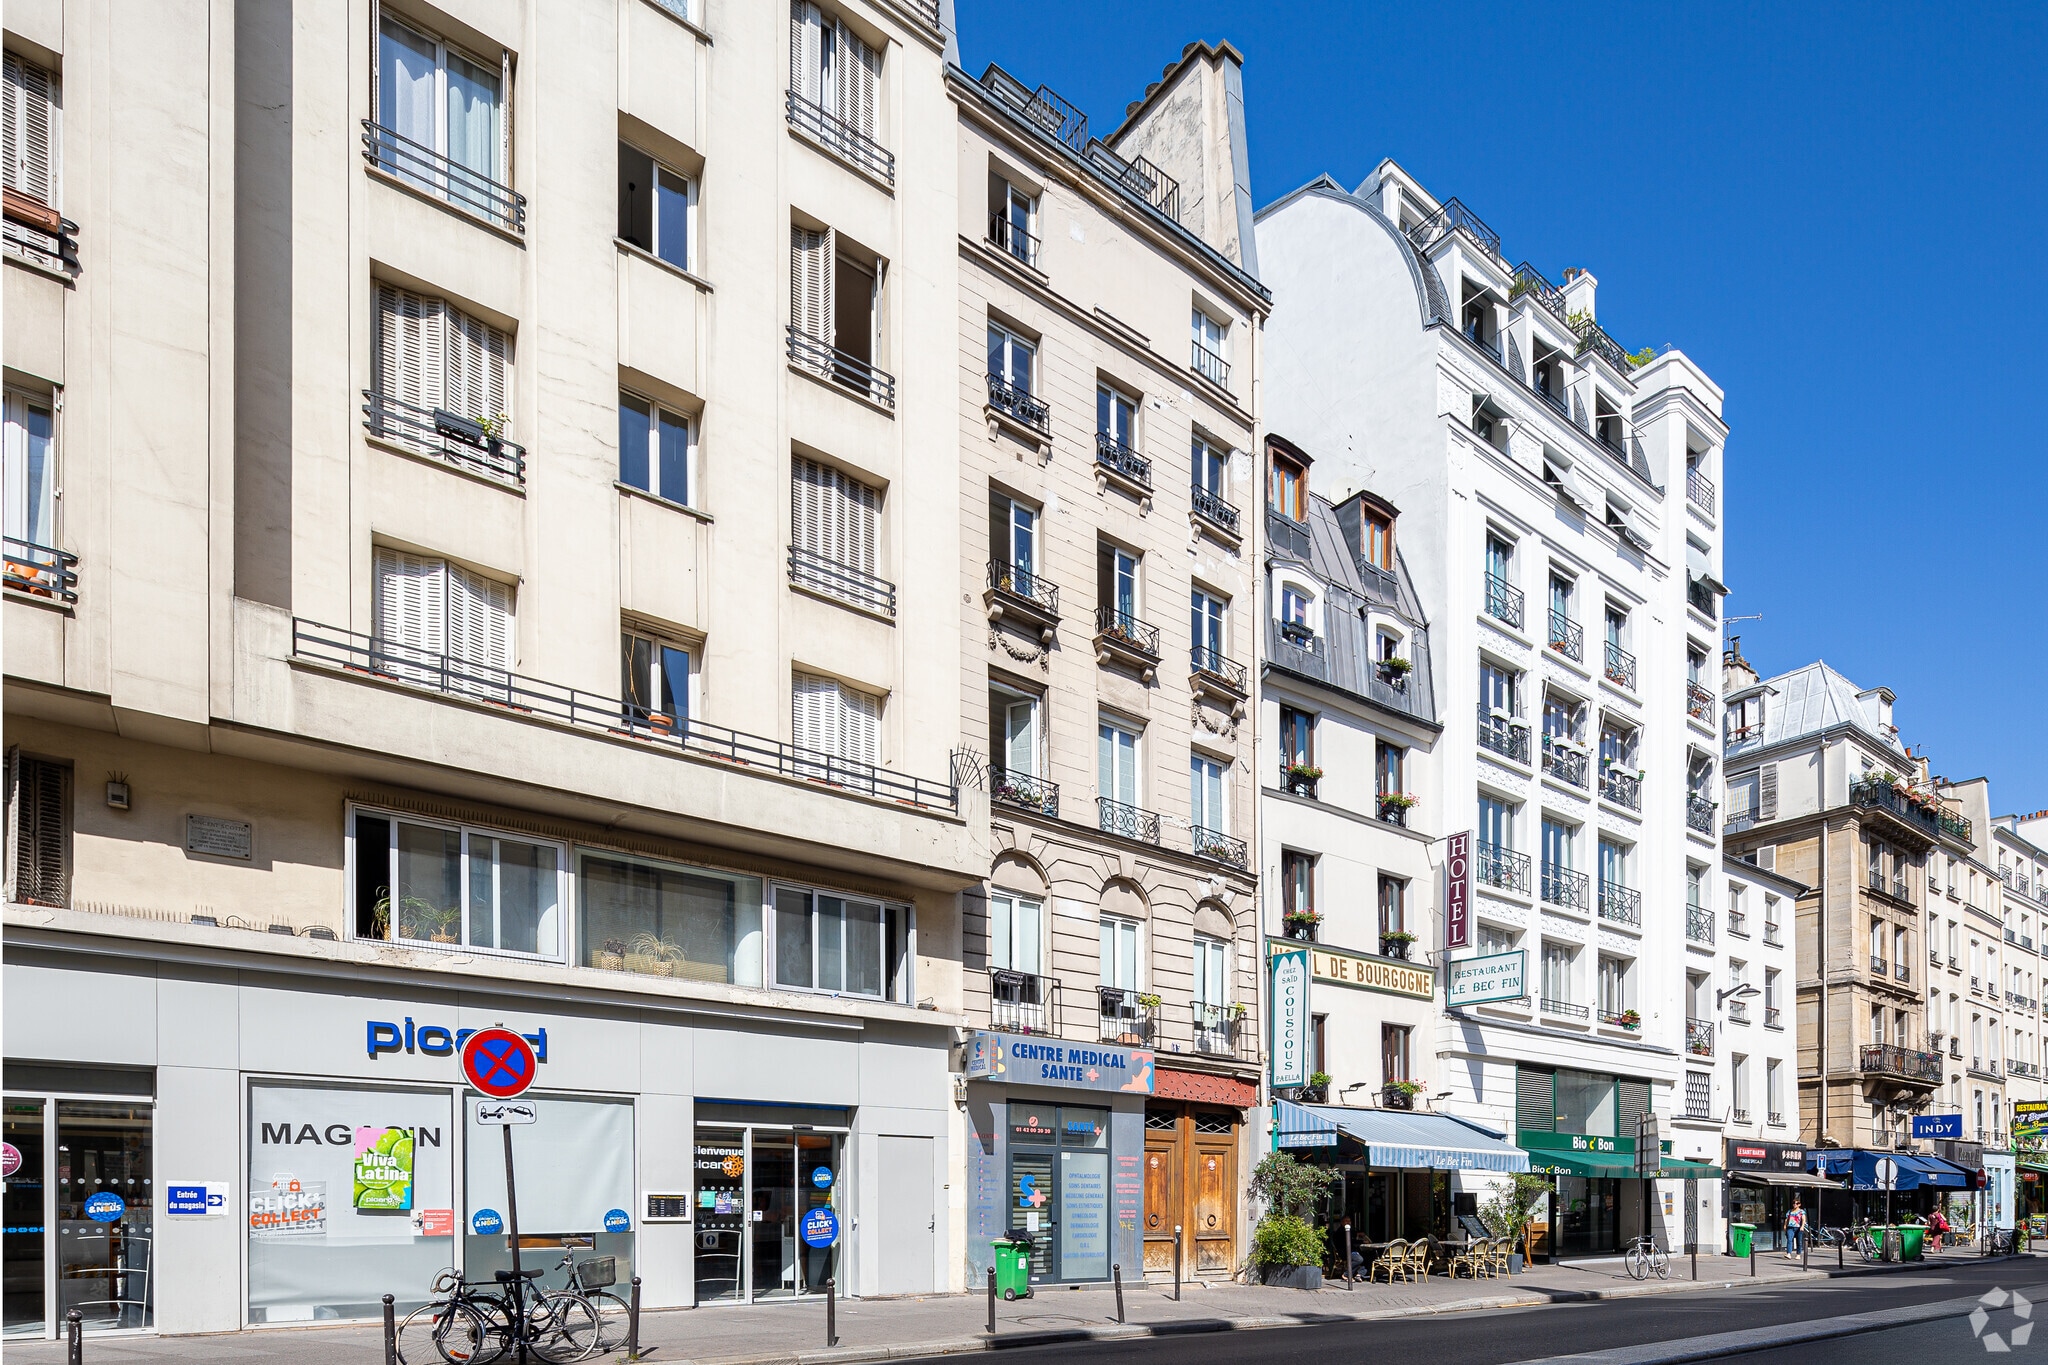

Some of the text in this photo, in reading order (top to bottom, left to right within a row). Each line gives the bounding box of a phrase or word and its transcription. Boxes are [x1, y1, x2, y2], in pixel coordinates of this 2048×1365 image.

[191, 819, 247, 832] VINCENT SCOTTO
[1450, 835, 1467, 944] HOTEL
[1282, 967, 1297, 975] CHEZ
[1330, 956, 1348, 980] DE
[1356, 962, 1430, 994] BOURGOGNE
[1454, 962, 1518, 979] RESTAURANT
[1281, 974, 1298, 985] SAÏD
[1452, 976, 1520, 995] LE BEC FIN
[1284, 985, 1295, 1071] COUSCOUS
[367, 1016, 546, 1058] picd
[1011, 1042, 1063, 1063] CENTRE
[1067, 1048, 1126, 1069] MEDICAL
[1041, 1063, 1083, 1082] SANTE
[1276, 1073, 1300, 1082] PAELLA
[1067, 1120, 1095, 1132] SANTÉ
[1919, 1123, 1953, 1134] INDY
[261, 1122, 441, 1147] MAGN
[1300, 1133, 1310, 1141] Bec
[1572, 1136, 1587, 1150] Bio
[1598, 1138, 1615, 1151] Bon
[361, 1151, 397, 1167] Viva
[1436, 1155, 1473, 1167] Le Bec Fin
[356, 1165, 409, 1181] Latina
[1532, 1165, 1546, 1174] Bio
[1554, 1166, 1571, 1175] Bon
[176, 1190, 198, 1199] Entrée
[169, 1201, 206, 1211] du magasin
[250, 1193, 312, 1213] CLICK
[250, 1207, 322, 1227] COLLECT
[807, 1221, 829, 1230] CLICK
[807, 1227, 833, 1236] COLLECT
